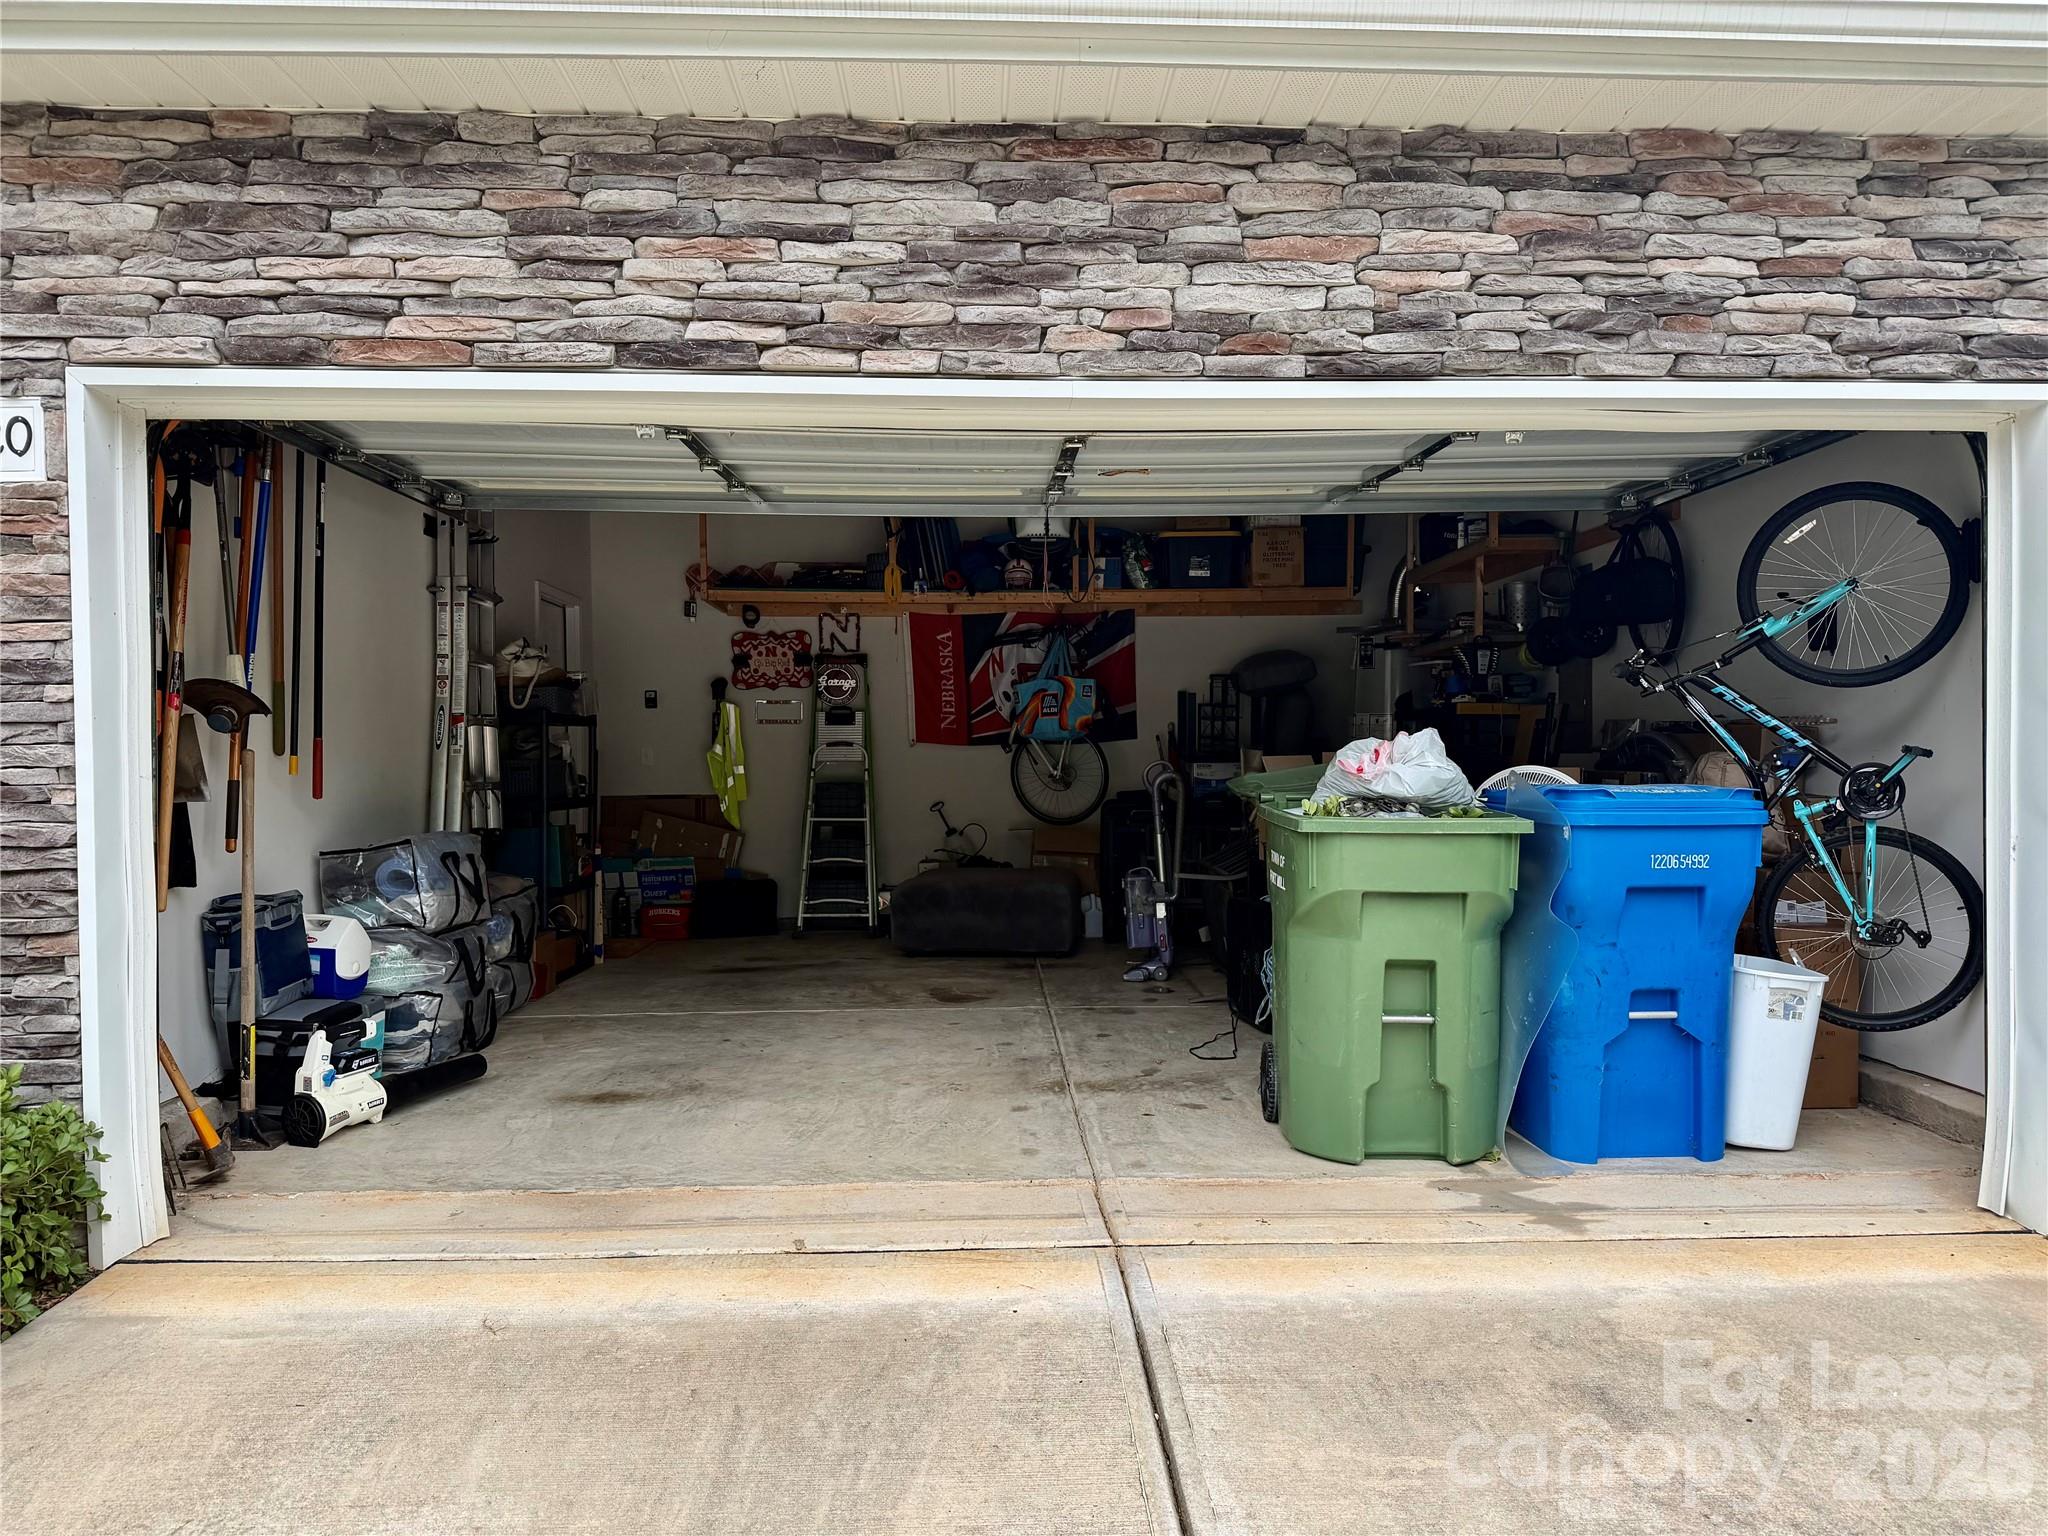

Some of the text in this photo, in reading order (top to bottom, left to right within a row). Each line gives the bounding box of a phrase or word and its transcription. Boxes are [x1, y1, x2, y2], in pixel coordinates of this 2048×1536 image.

[0, 415, 33, 457] 0
[818, 675, 857, 691] Garage
[936, 631, 957, 729] NEBRASKA
[1650, 854, 1710, 869] 1220654992
